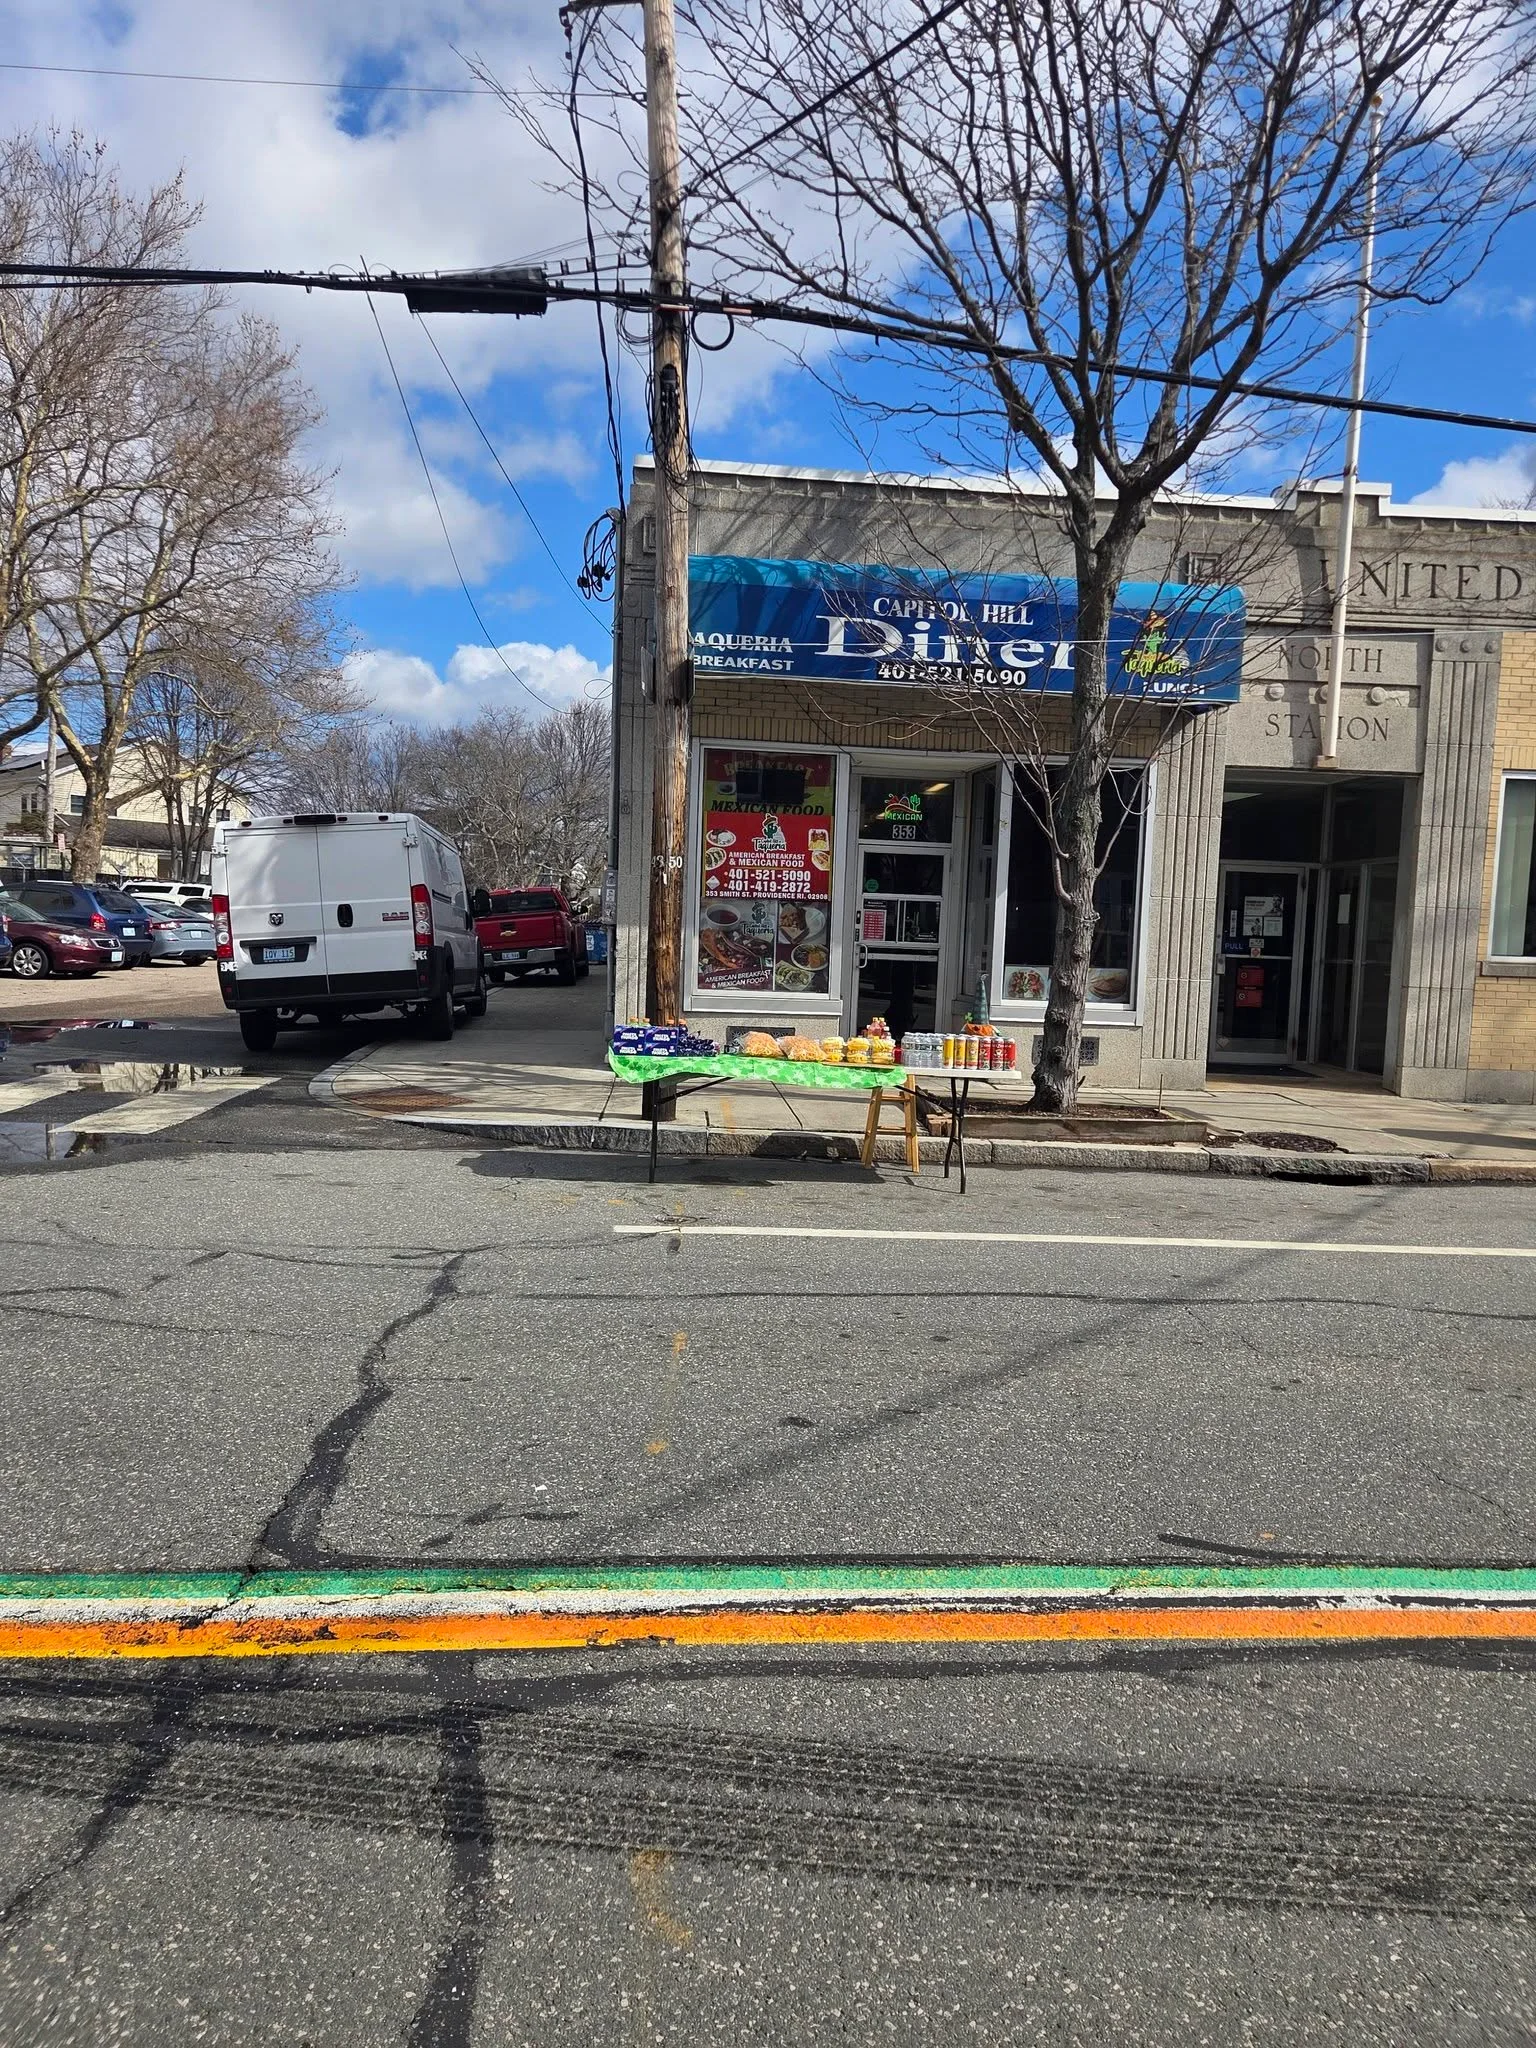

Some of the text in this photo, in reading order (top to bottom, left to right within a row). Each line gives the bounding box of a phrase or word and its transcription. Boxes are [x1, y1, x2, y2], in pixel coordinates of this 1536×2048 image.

[873, 597, 1034, 626] CAPITOL HILL
[693, 632, 794, 653] AQUERIA
[814, 614, 1076, 671] Diner
[693, 654, 795, 671] BREAKFAST
[1264, 712, 1390, 742] STAION
[711, 799, 825, 816] MEXICAN FOOD
[885, 812, 923, 821] MEXICAN
[892, 825, 916, 839] 353
[668, 856, 683, 869] 50
[728, 851, 806, 861] AMERICAN BREAKFAST
[729, 858, 805, 868] & MEXICAN FOOD
[728, 869, 811, 881] 401-521-5090
[728, 881, 811, 893] 401-419-2872
[705, 890, 718, 898] 353
[753, 891, 795, 900] PROVIDENCE
[1224, 942, 1244, 950] PULL
[704, 969, 771, 984] AMERICAN BREAKFAST
[717, 977, 746, 988] MEXICAN
[746, 976, 766, 985] FOOD
